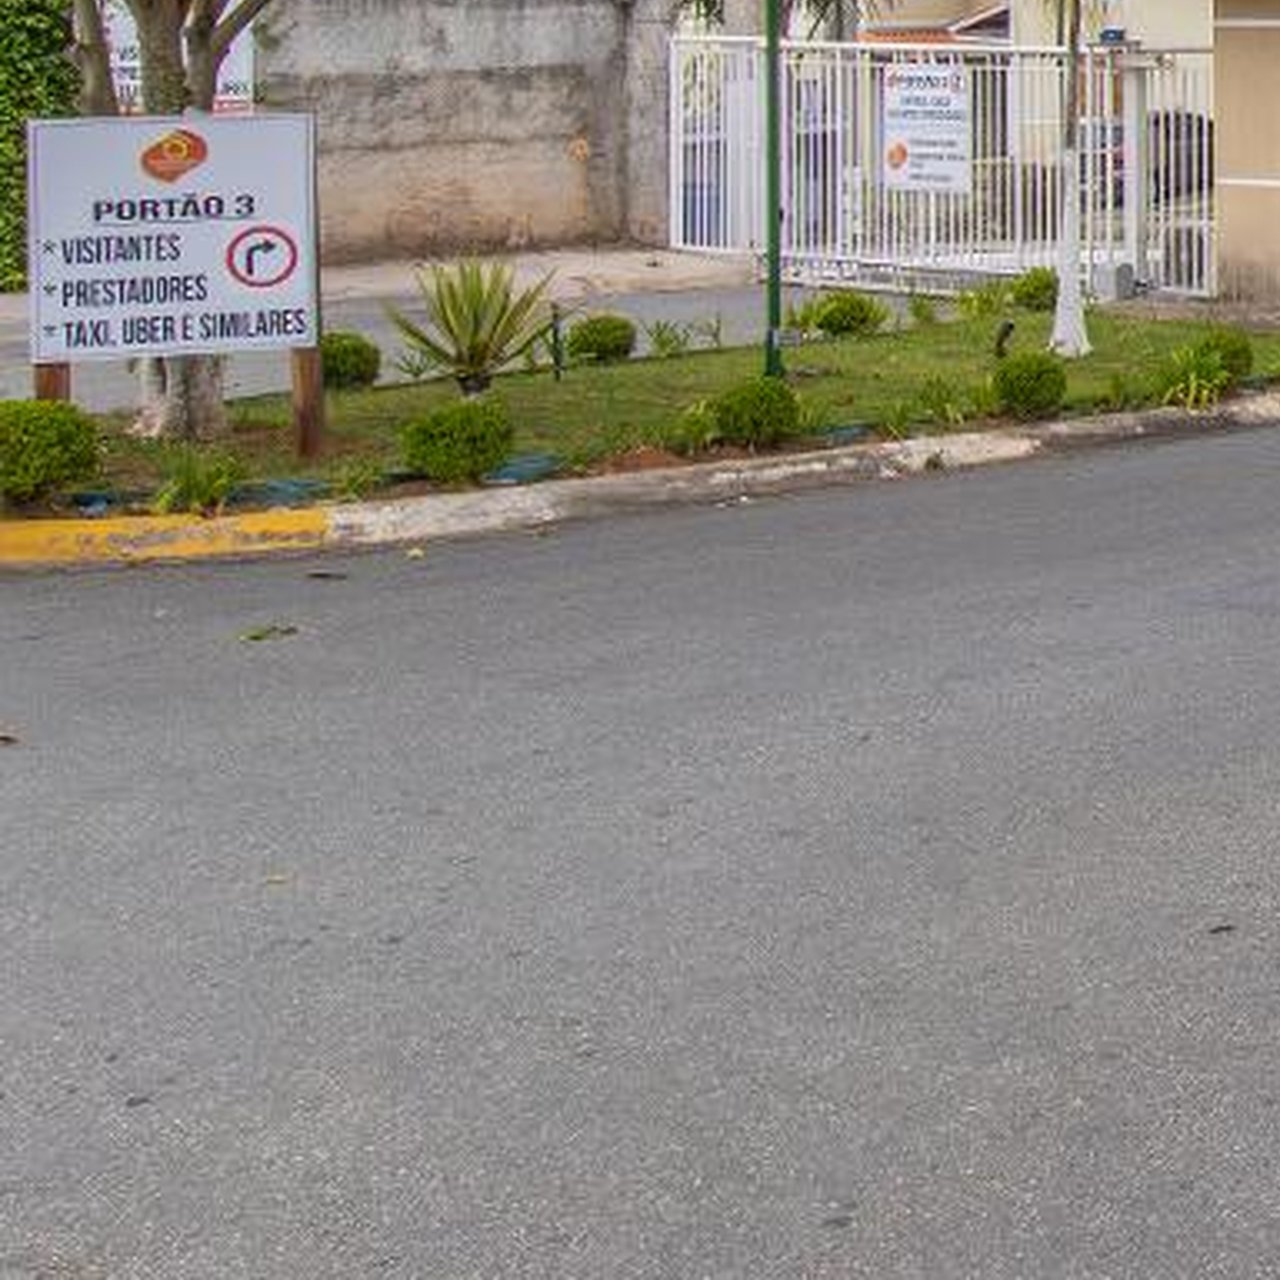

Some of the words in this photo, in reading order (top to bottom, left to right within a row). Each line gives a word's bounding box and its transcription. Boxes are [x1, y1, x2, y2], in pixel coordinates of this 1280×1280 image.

[93, 191, 224, 222] PORTÃO
[235, 193, 255, 217] 3
[61, 233, 182, 265] VISITANTES
[62, 274, 208, 308] PRESTADORES
[121, 317, 177, 345] UBER
[181, 316, 193, 341] E
[198, 308, 308, 338] SIMILARES
